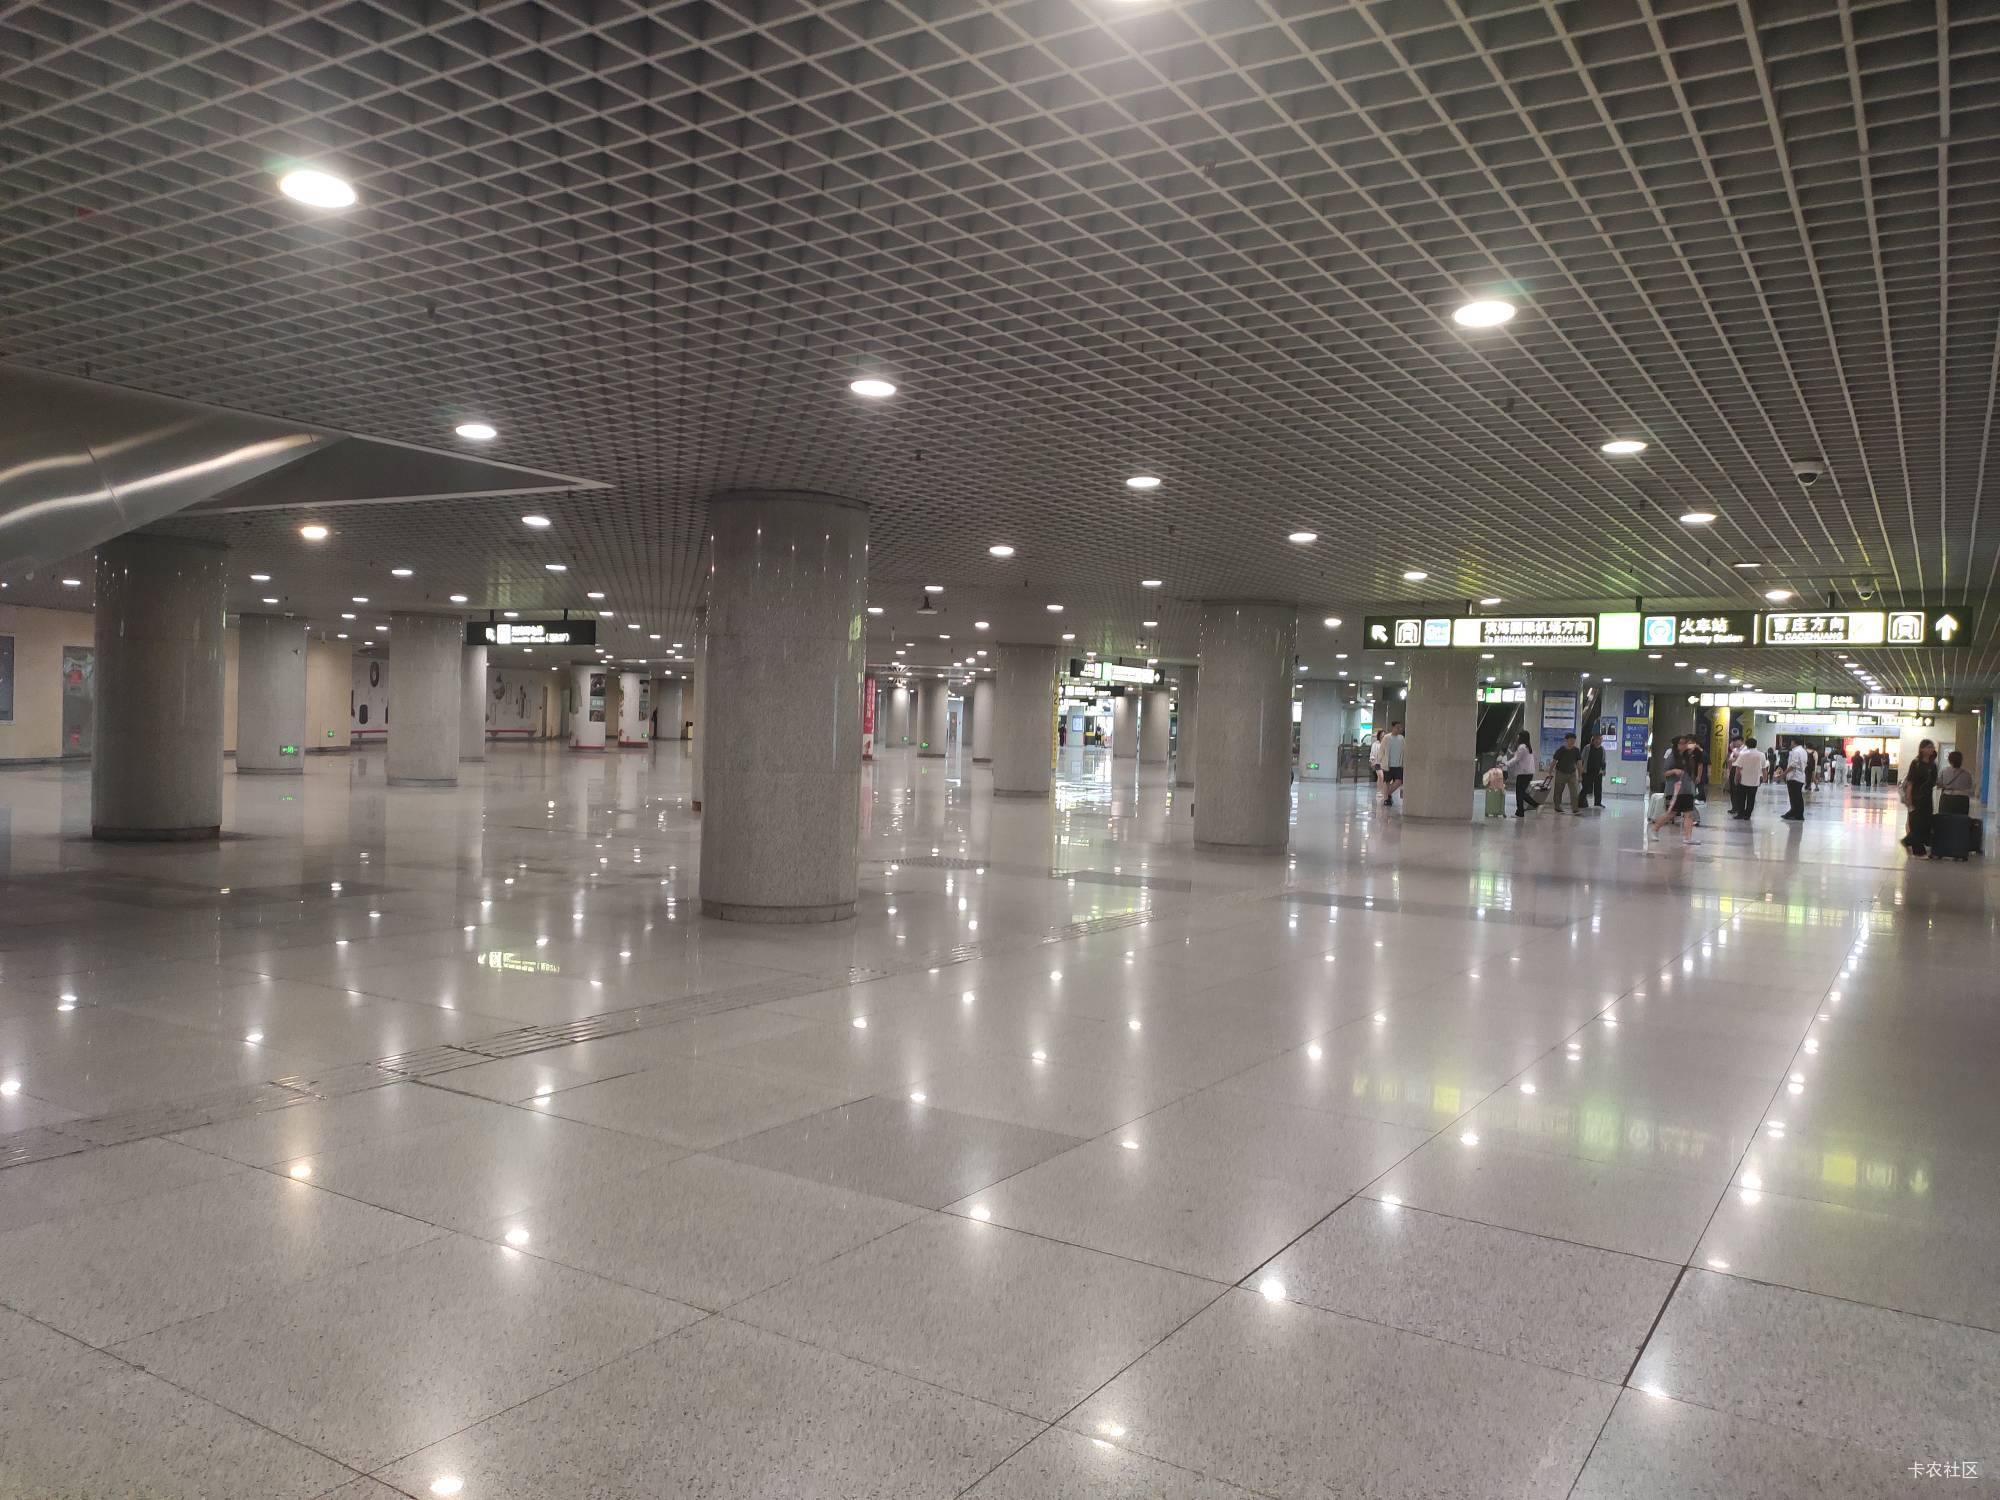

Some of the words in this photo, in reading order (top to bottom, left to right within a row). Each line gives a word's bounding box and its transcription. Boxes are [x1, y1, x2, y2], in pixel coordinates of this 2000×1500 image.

[1680, 617, 1728, 633] 火车站
[1714, 724, 1724, 737] 2
